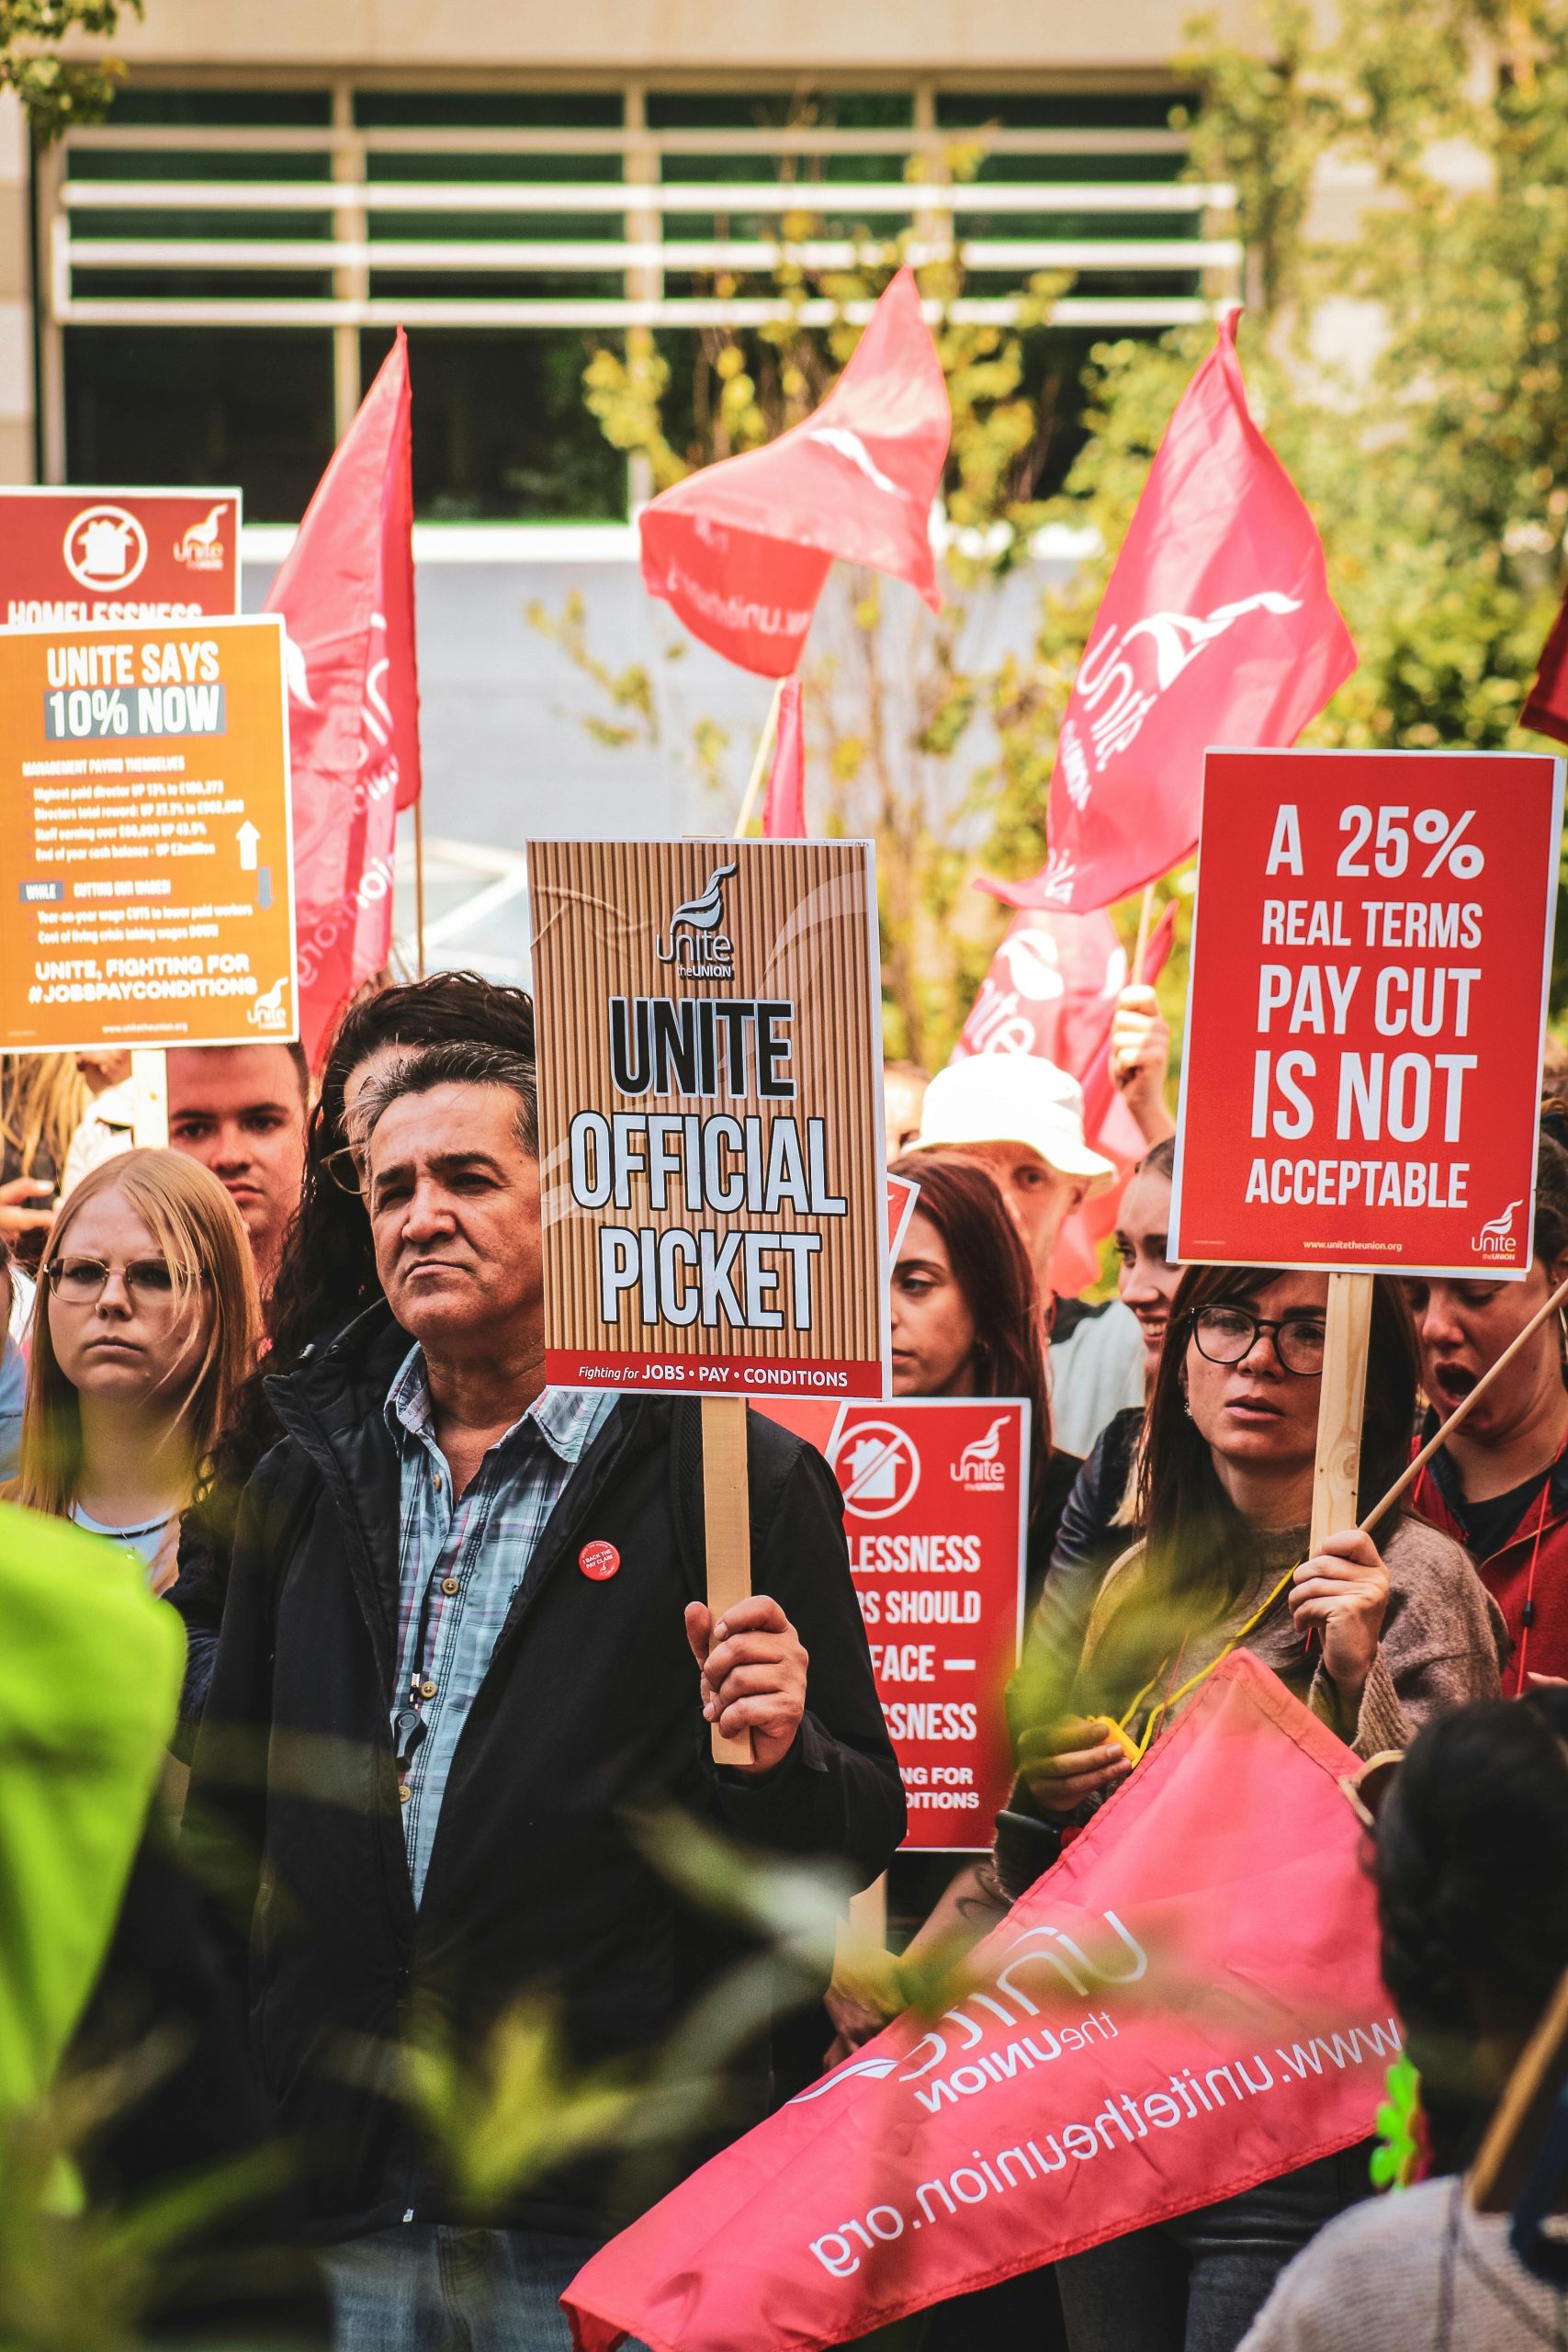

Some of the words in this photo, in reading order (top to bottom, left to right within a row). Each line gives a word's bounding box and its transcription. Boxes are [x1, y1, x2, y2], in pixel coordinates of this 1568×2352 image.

[47, 647, 134, 687] UNITE
[141, 641, 220, 684] SAYS
[50, 688, 129, 737] 10%
[138, 684, 220, 734] NOW
[1266, 804, 1303, 876] A
[1337, 805, 1484, 880] 25%
[1262, 899, 1351, 946] REAL
[1361, 902, 1483, 949] TERMS
[28, 977, 257, 1003] #JOBSPAYCONDITIONS
[35, 960, 102, 981] UNITE,
[106, 956, 203, 978] FIGHTING
[208, 954, 250, 973] FOR
[1258, 965, 1362, 1035] PAY
[1374, 967, 1482, 1037] CUT
[609, 996, 797, 1100] UNITE
[1251, 1050, 1316, 1139] IS
[1337, 1052, 1477, 1143] NOT
[569, 1110, 848, 1216] OFFICIAL
[1245, 1159, 1470, 1209] ACCEPTABLE
[1303, 1240, 1403, 1251] www.unitetheunion.org
[599, 1226, 822, 1331] PICKET
[579, 1366, 620, 1381] Fighting
[623, 1368, 639, 1381] for
[642, 1364, 684, 1380] JOBS
[699, 1367, 729, 1382] PAY
[743, 1368, 848, 1387] CONDITIONS
[847, 1535, 981, 1573] LESSNESS
[885, 1590, 981, 1624] SHOULD
[931, 1767, 974, 1785] FOR
[906, 1792, 980, 1809] DITIONS
